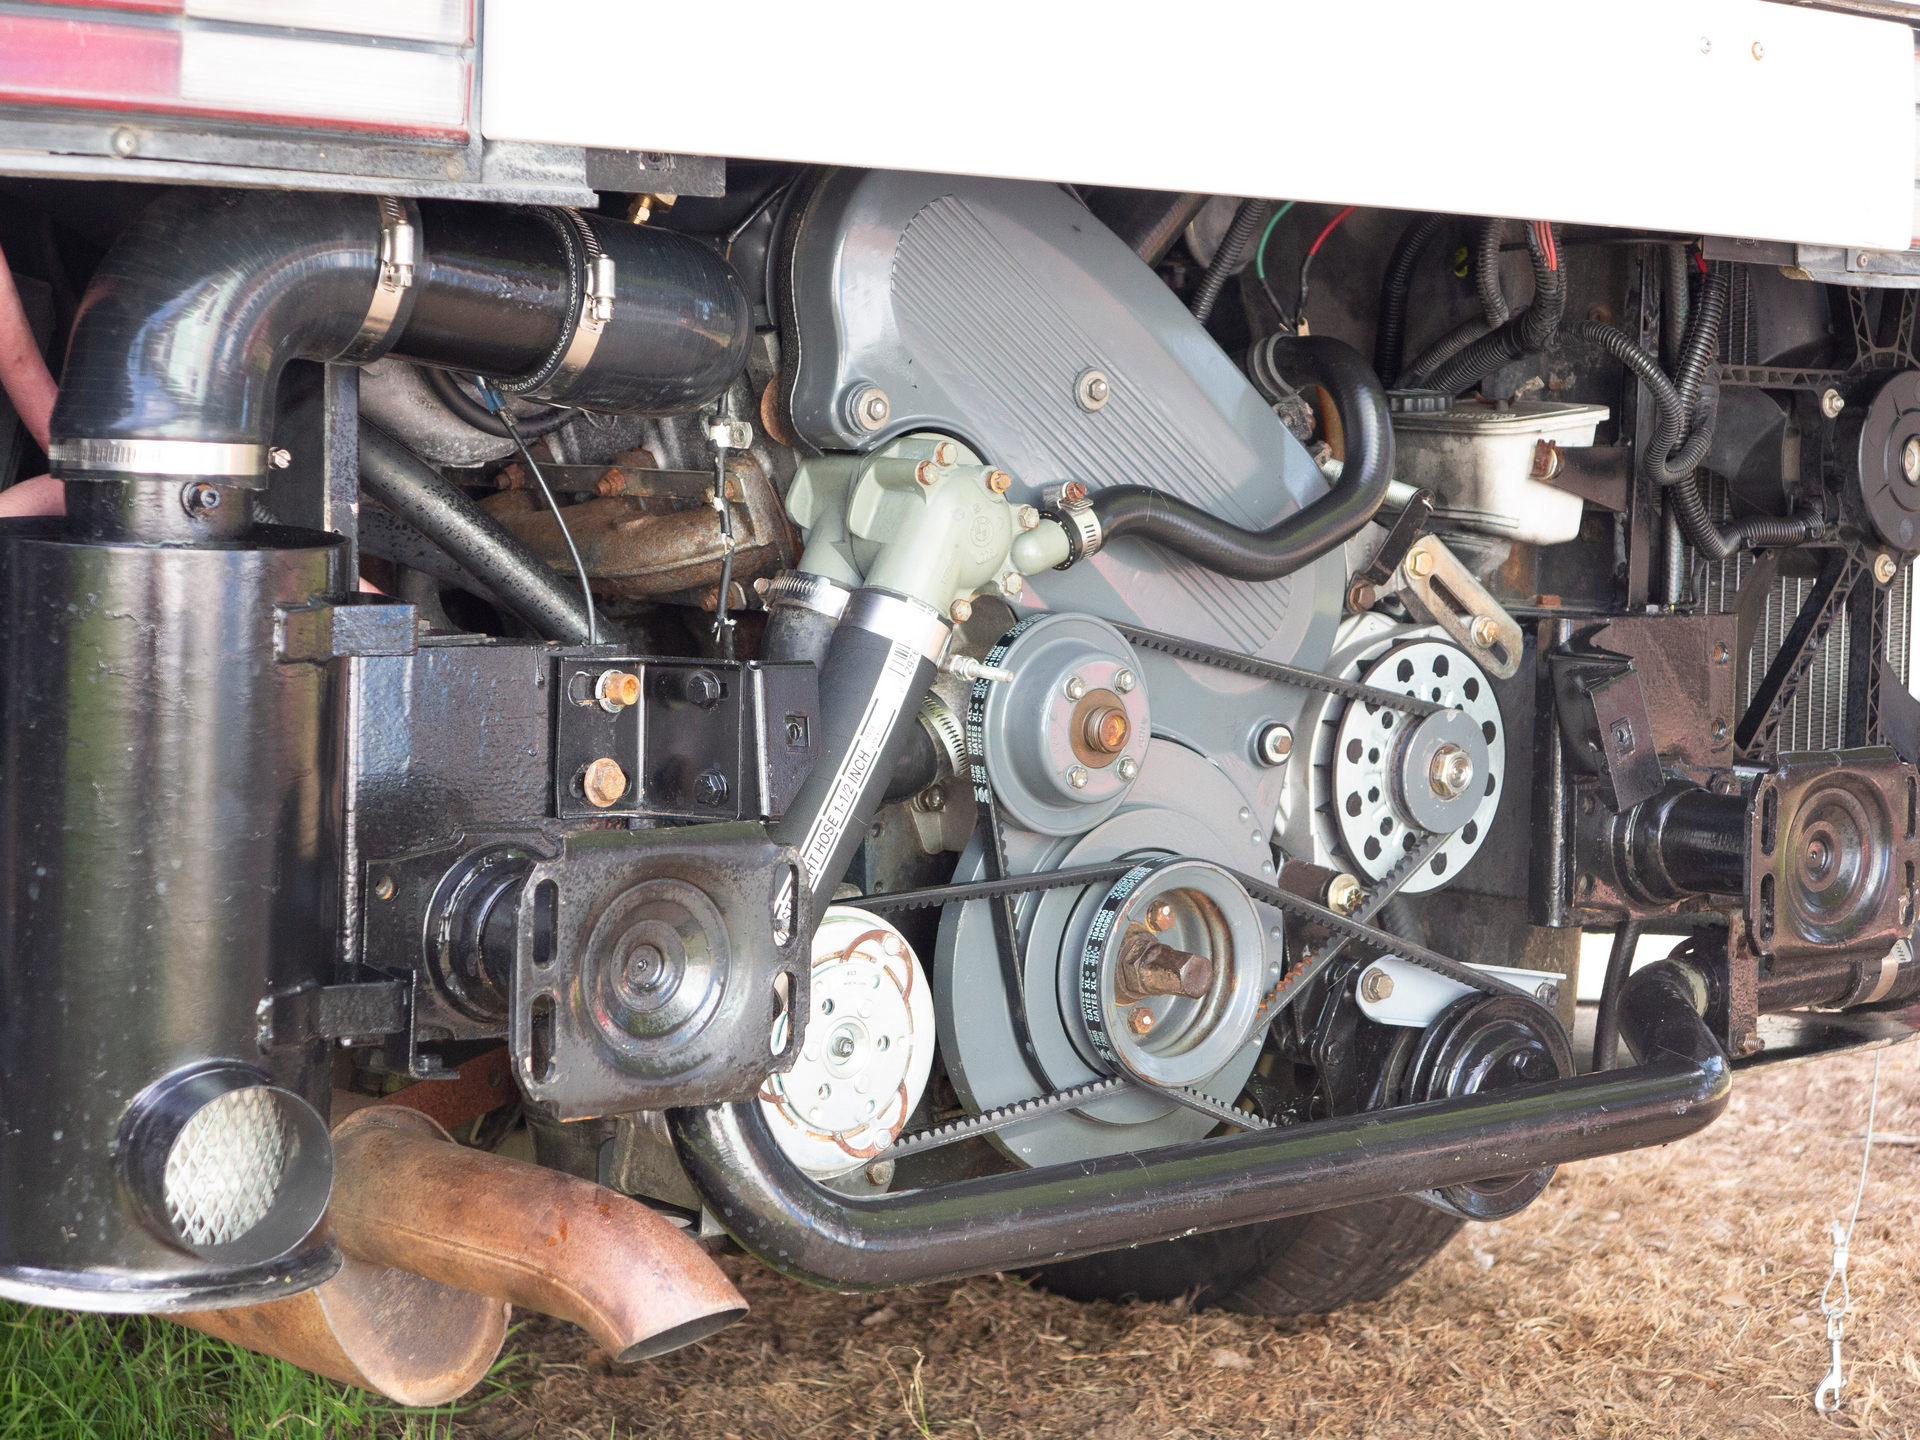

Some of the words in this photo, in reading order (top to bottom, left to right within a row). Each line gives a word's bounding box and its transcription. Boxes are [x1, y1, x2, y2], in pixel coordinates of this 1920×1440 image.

[813, 815, 839, 855] HOSE
[834, 783, 854, 814] 1-1/2
[847, 749, 871, 785] INCH
[1085, 992, 1094, 1021] GATES
[1091, 993, 1100, 1022] GATES
